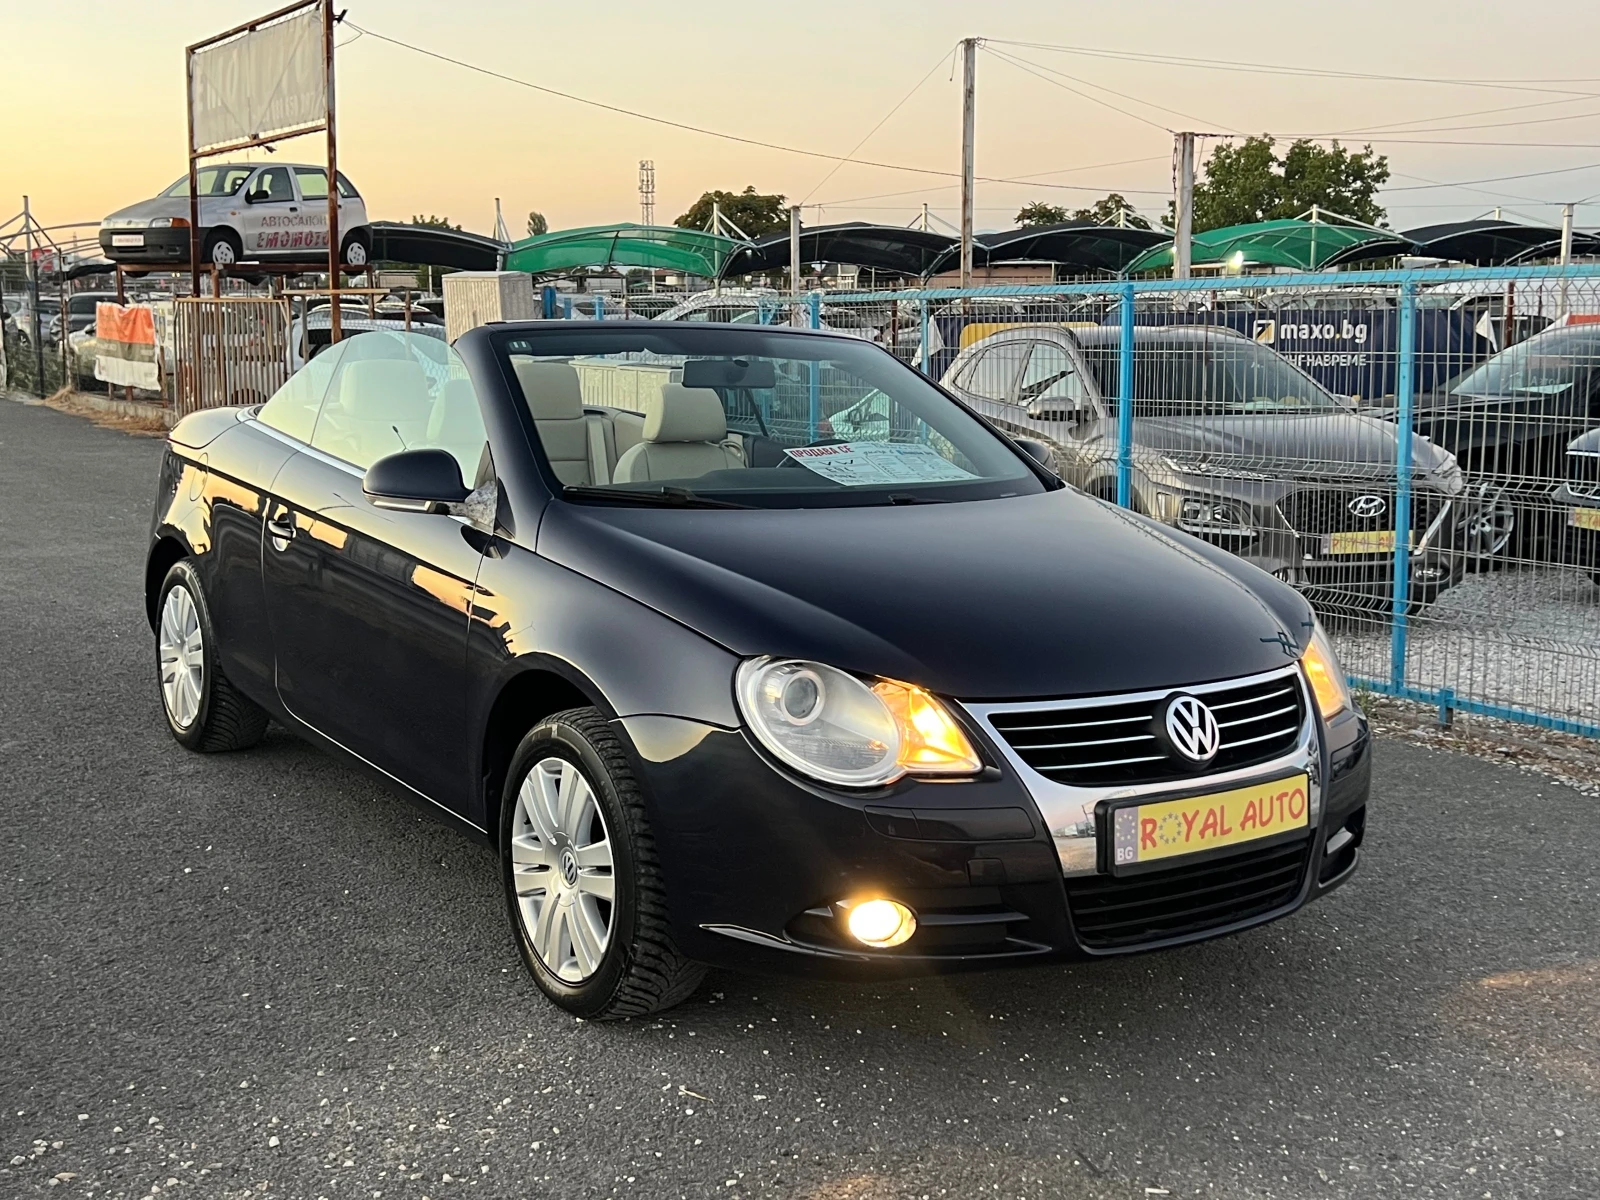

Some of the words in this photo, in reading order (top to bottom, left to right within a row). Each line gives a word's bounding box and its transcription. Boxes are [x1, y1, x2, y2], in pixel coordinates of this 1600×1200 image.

[1280, 319, 1368, 344] maxo.bg
[789, 447, 839, 457] ПРОДАВА
[838, 444, 855, 453] СЕ
[1140, 805, 1232, 850] ROYAL
[1239, 788, 1305, 831] AUTO
[1117, 846, 1133, 861] BG
